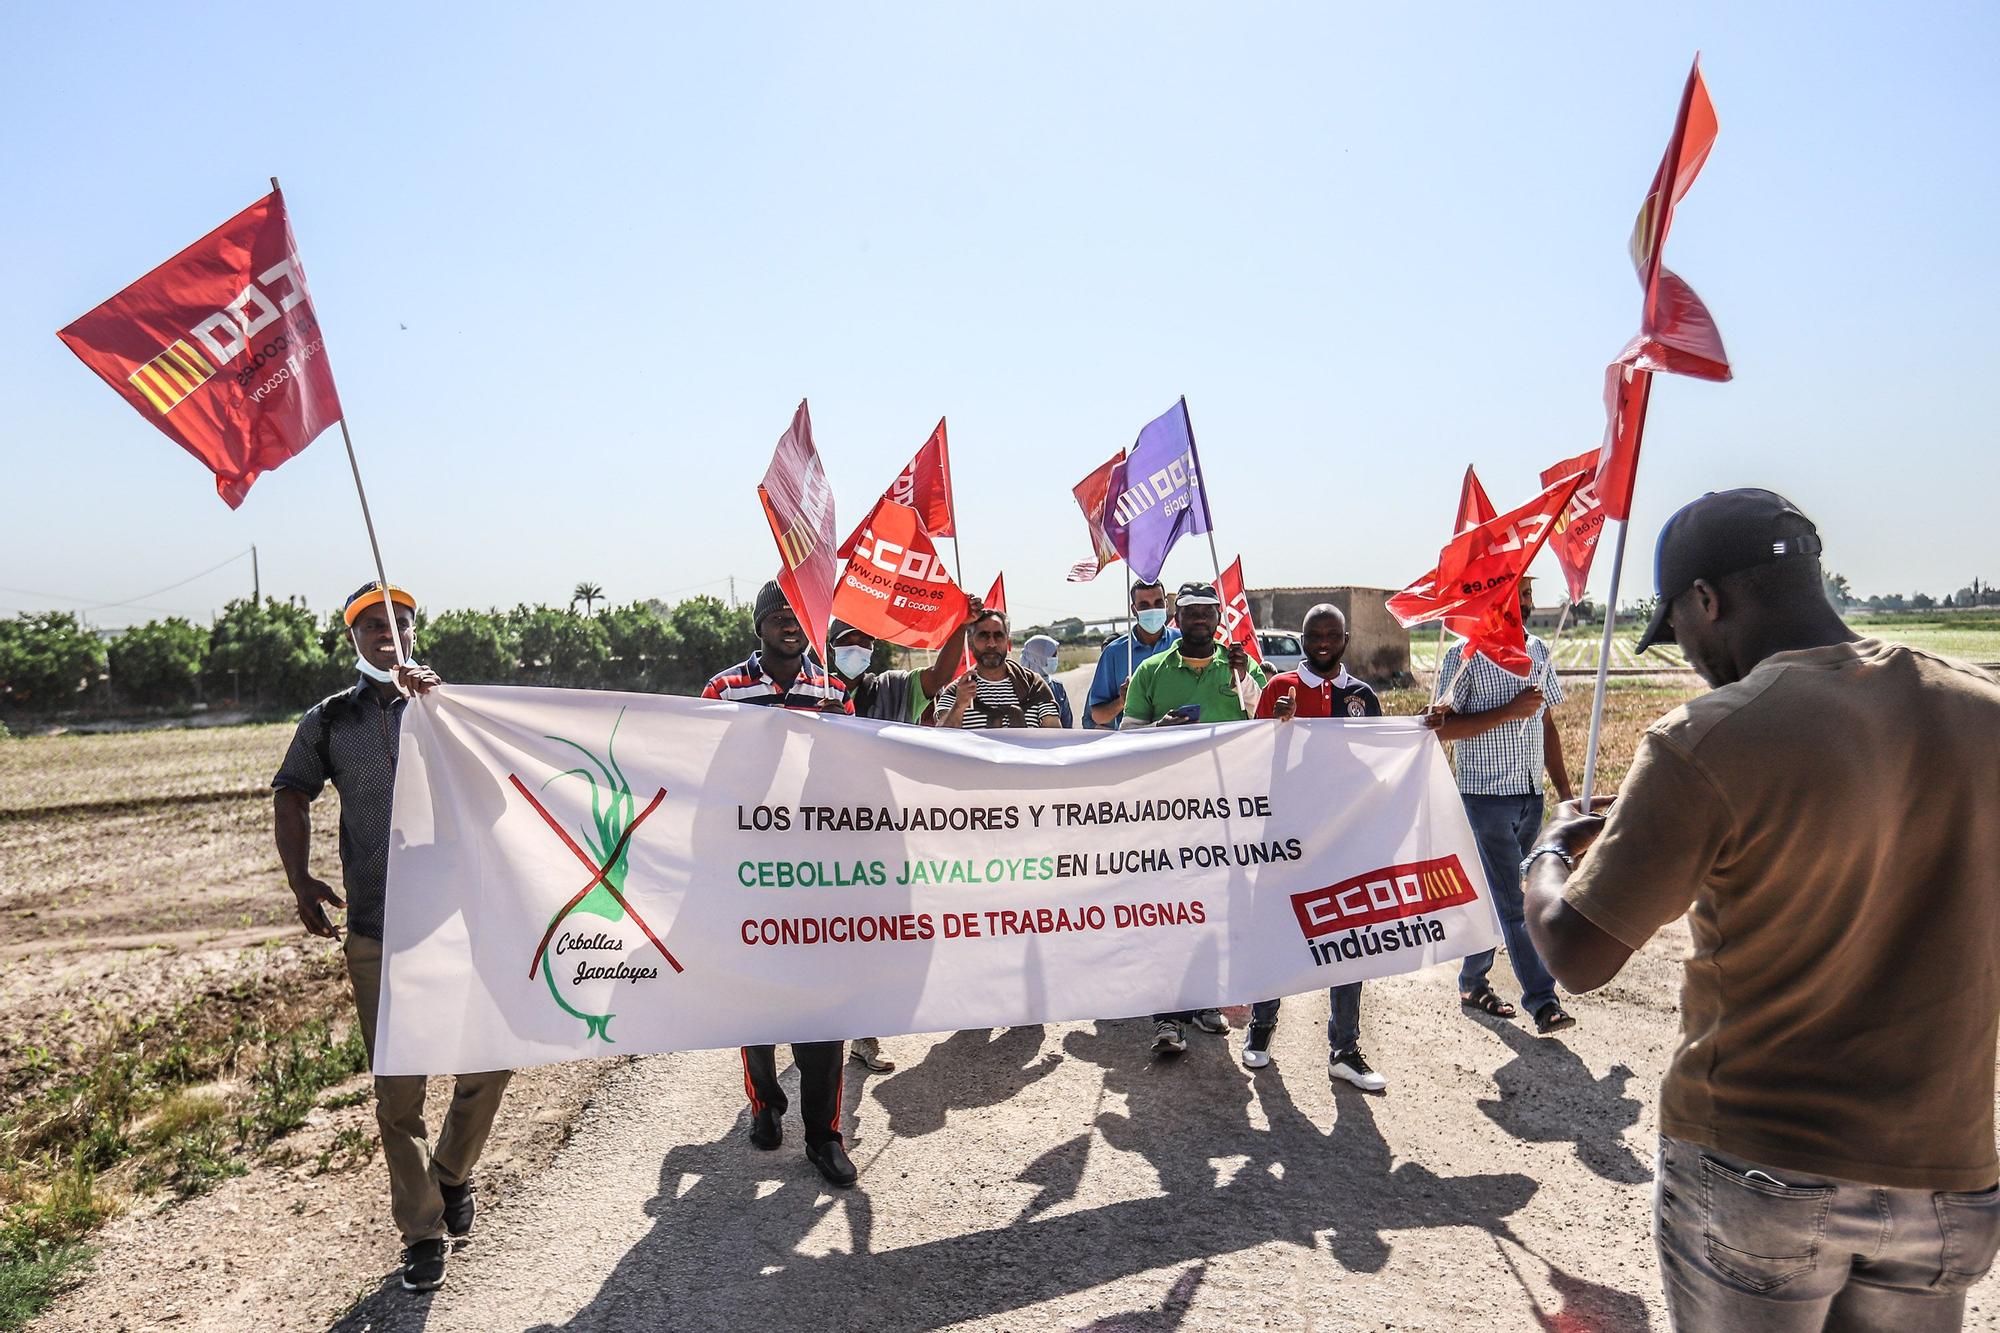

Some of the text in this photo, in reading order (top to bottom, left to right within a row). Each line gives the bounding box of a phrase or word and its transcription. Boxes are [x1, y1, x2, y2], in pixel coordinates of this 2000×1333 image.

[846, 575, 890, 600] @ccoopv
[738, 796, 1272, 832] LOS TRABAJADORES Y TRABAJADORAS DE
[738, 838, 1302, 887] CEBOLLAS JAVALOYES EN LUCHA POR UNAS
[1304, 873, 1422, 926] CCOO
[742, 901, 1205, 945] CONDICIONES DE TRABAJO DIGNAS
[1308, 916, 1445, 966] indústria
[556, 932, 623, 955] Cebollas
[573, 961, 657, 985] Javaloyes
